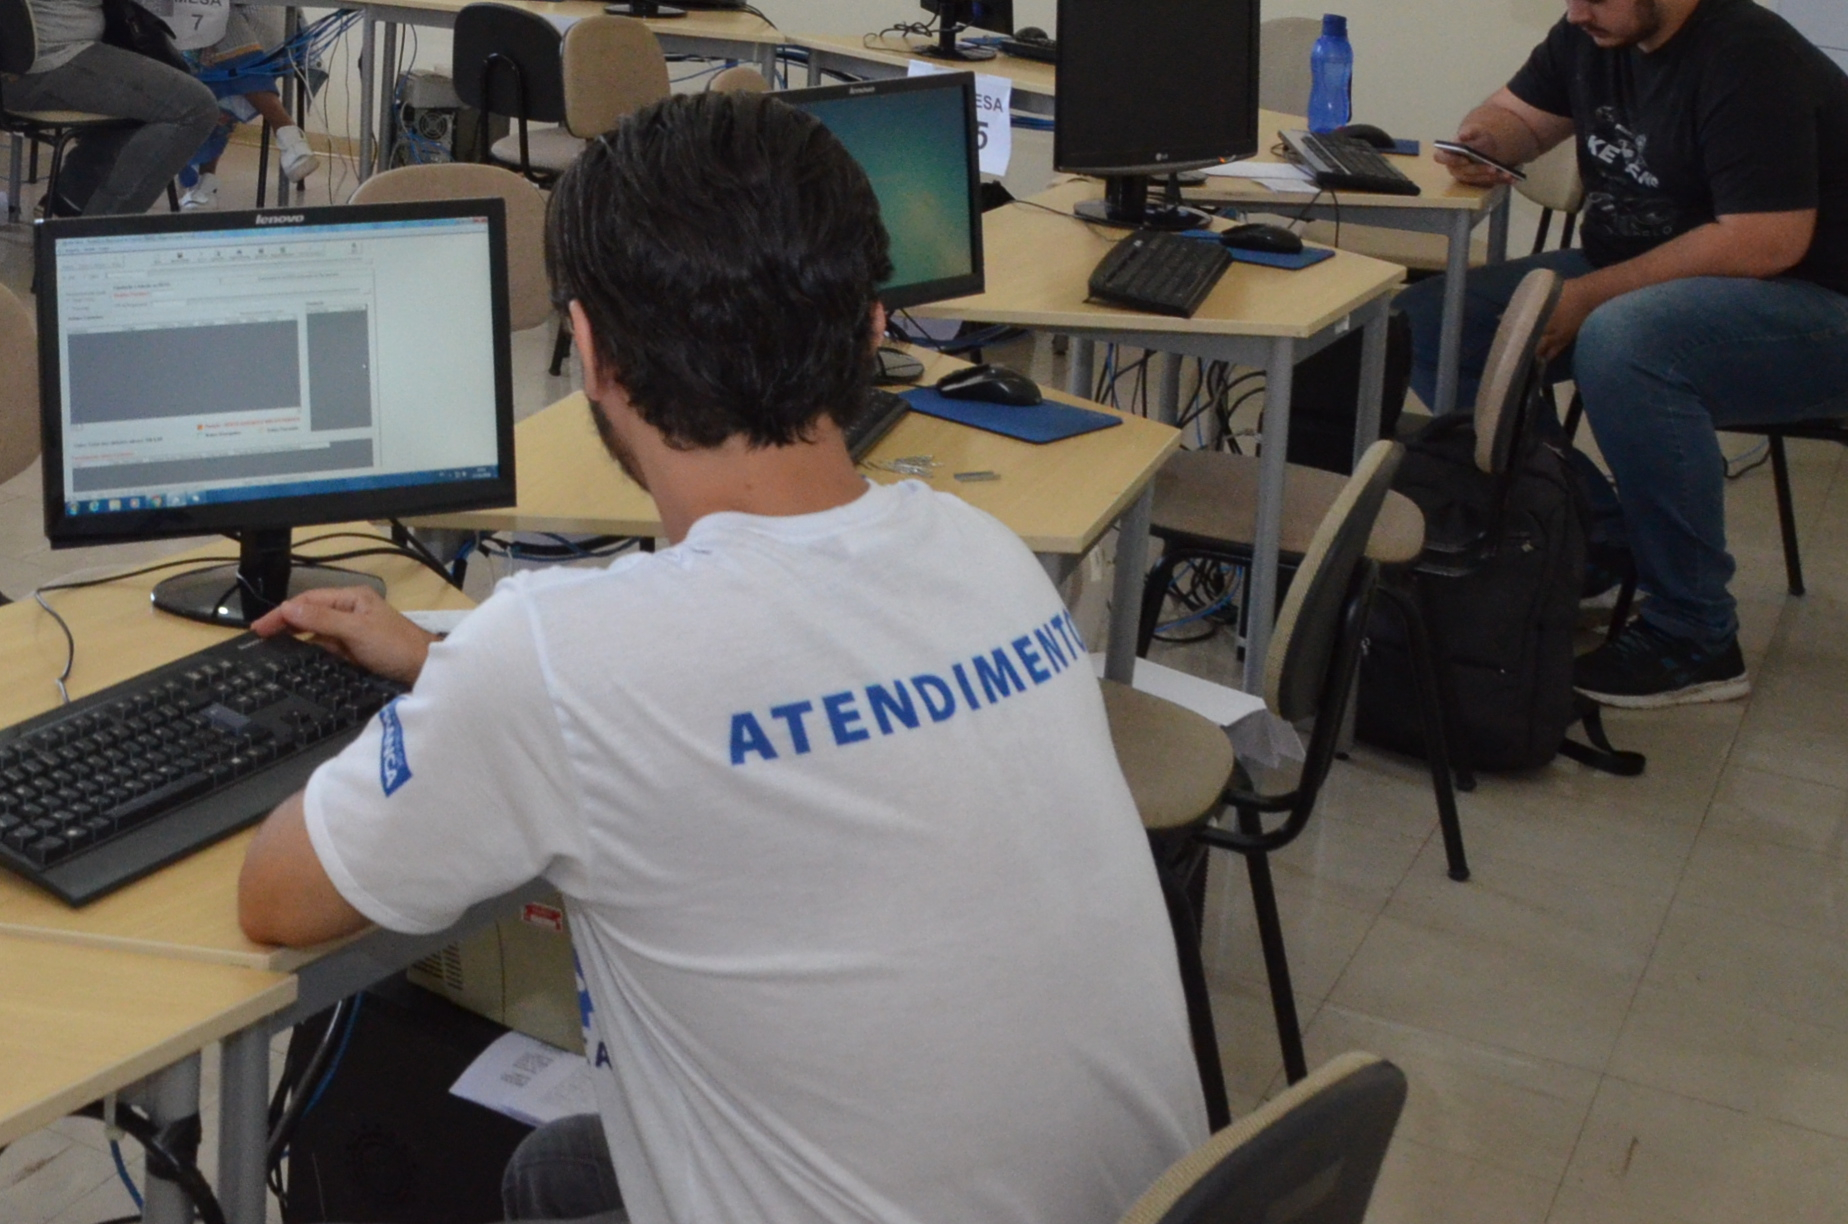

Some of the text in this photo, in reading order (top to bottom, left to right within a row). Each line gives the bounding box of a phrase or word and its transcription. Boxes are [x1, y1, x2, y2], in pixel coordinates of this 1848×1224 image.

[191, 13, 205, 31] 7
[974, 93, 1004, 113] ESA
[255, 214, 305, 225] lenovo
